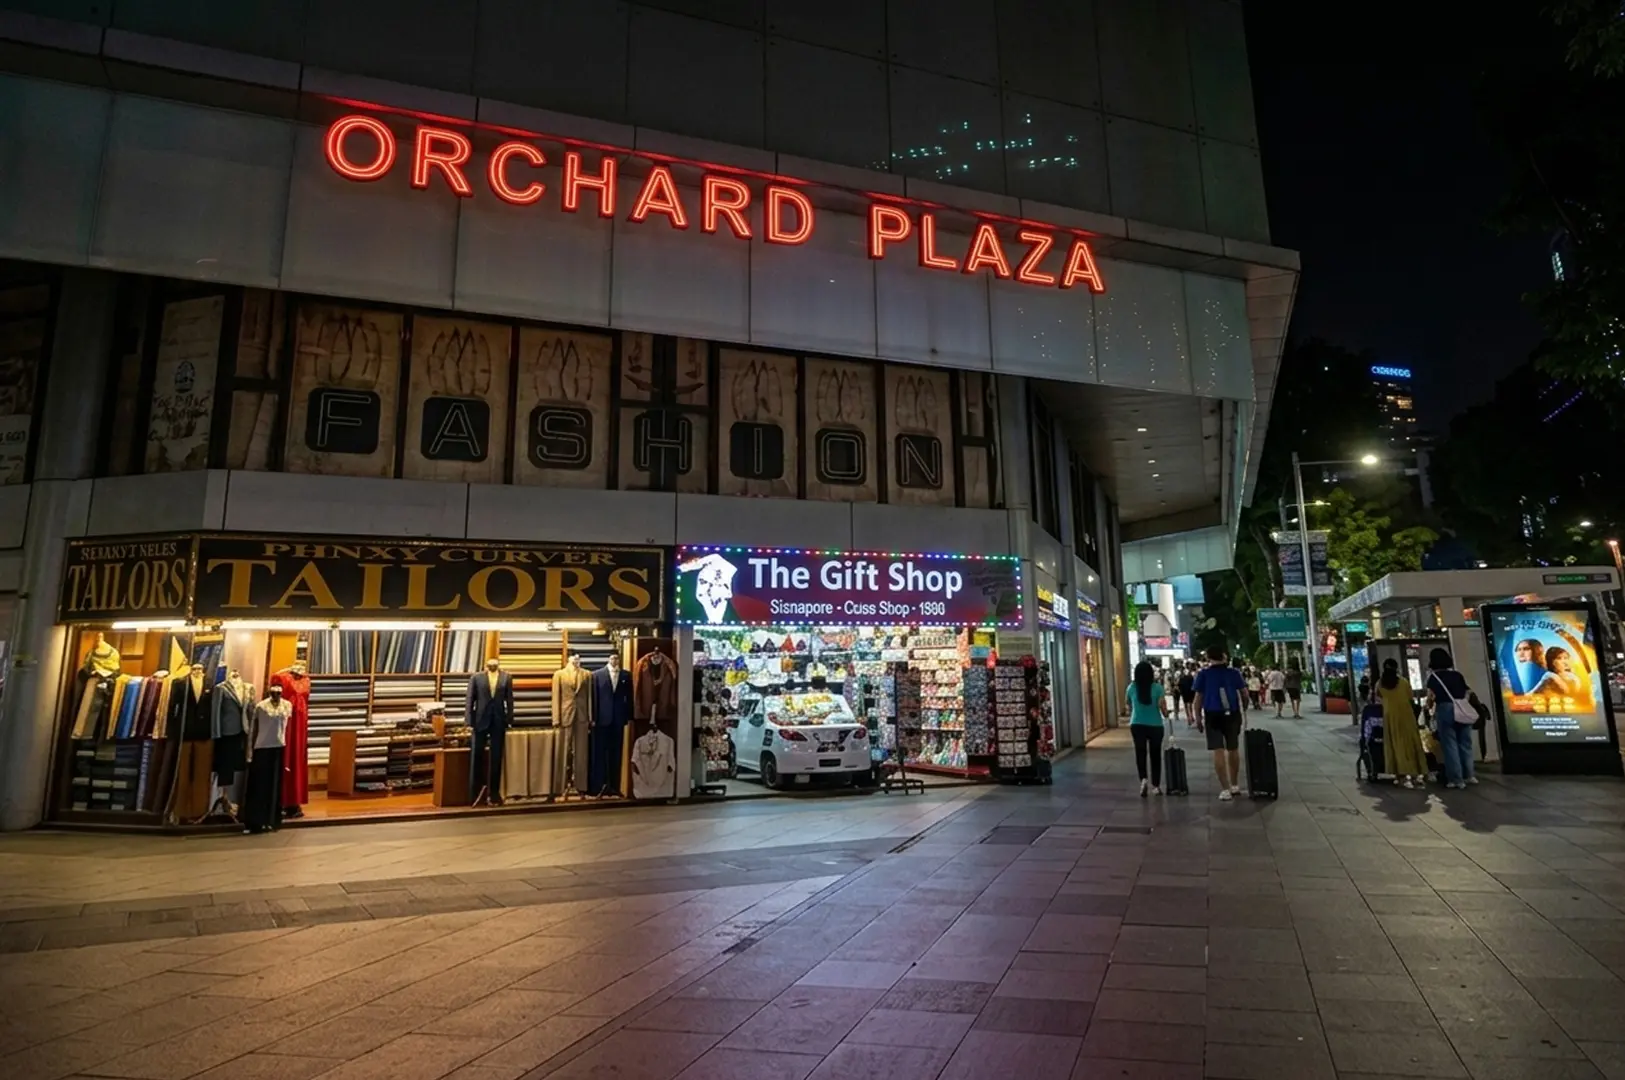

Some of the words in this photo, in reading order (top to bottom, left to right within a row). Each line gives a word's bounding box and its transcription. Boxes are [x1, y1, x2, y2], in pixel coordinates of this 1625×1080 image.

[325, 114, 815, 244] ORCHARD
[868, 205, 1105, 292] PLAZA
[314, 390, 942, 488] FASHION
[261, 542, 428, 562] PHNXY
[438, 548, 616, 566] CURVER
[748, 557, 810, 589] The
[820, 560, 879, 591] Gift
[888, 561, 963, 600] Shop
[67, 558, 187, 612] TAILORS
[206, 558, 652, 613] TAILORS
[770, 599, 833, 617] Sisnapore
